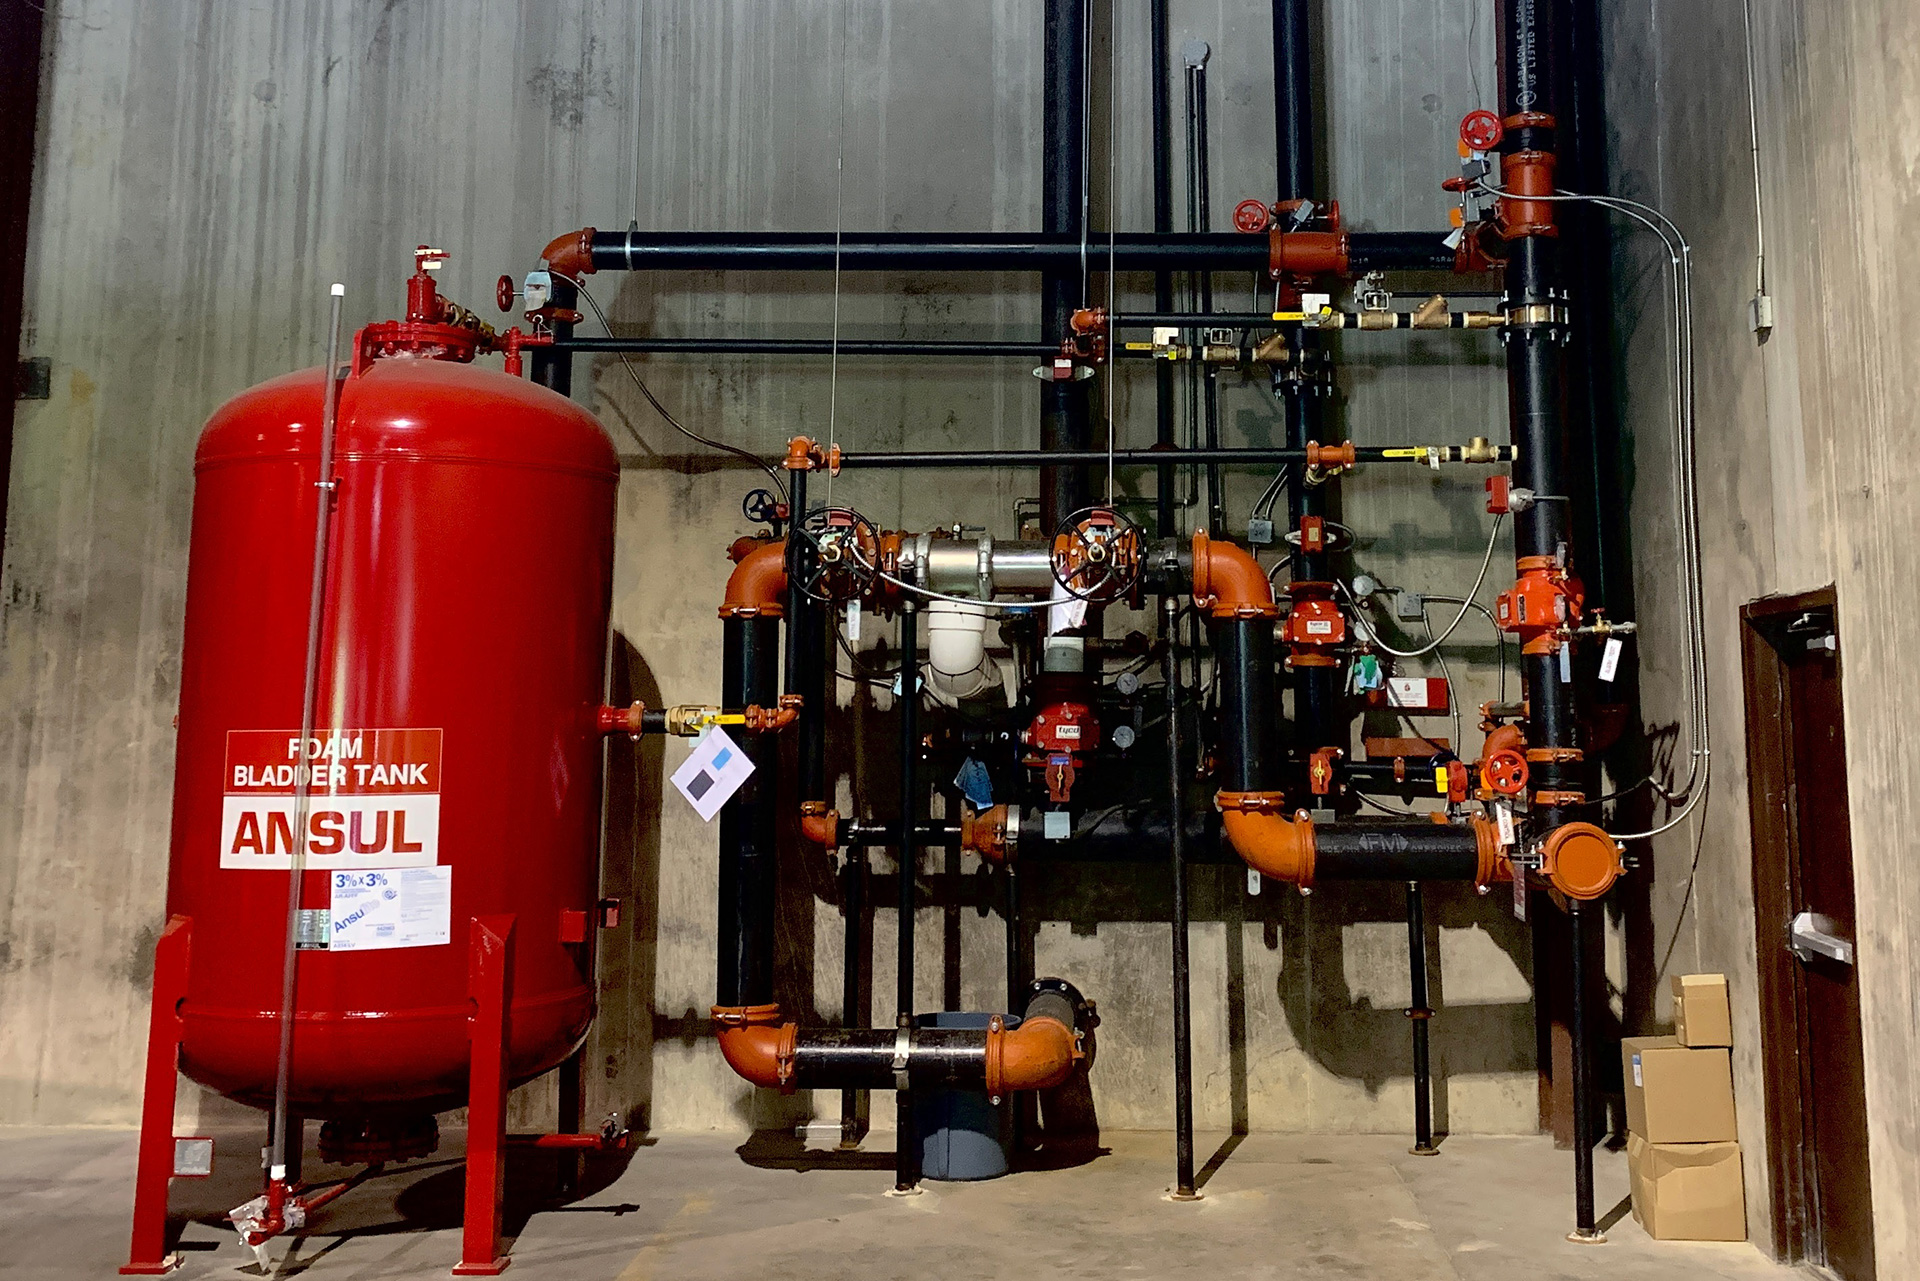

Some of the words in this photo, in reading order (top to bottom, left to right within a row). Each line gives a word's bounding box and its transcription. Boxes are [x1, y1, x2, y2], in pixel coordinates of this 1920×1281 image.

[1058, 726, 1080, 735] tyco
[288, 737, 362, 760] FOAM
[234, 765, 346, 787] BLADDER
[353, 763, 429, 786] TANK
[230, 810, 423, 855] ANSUL
